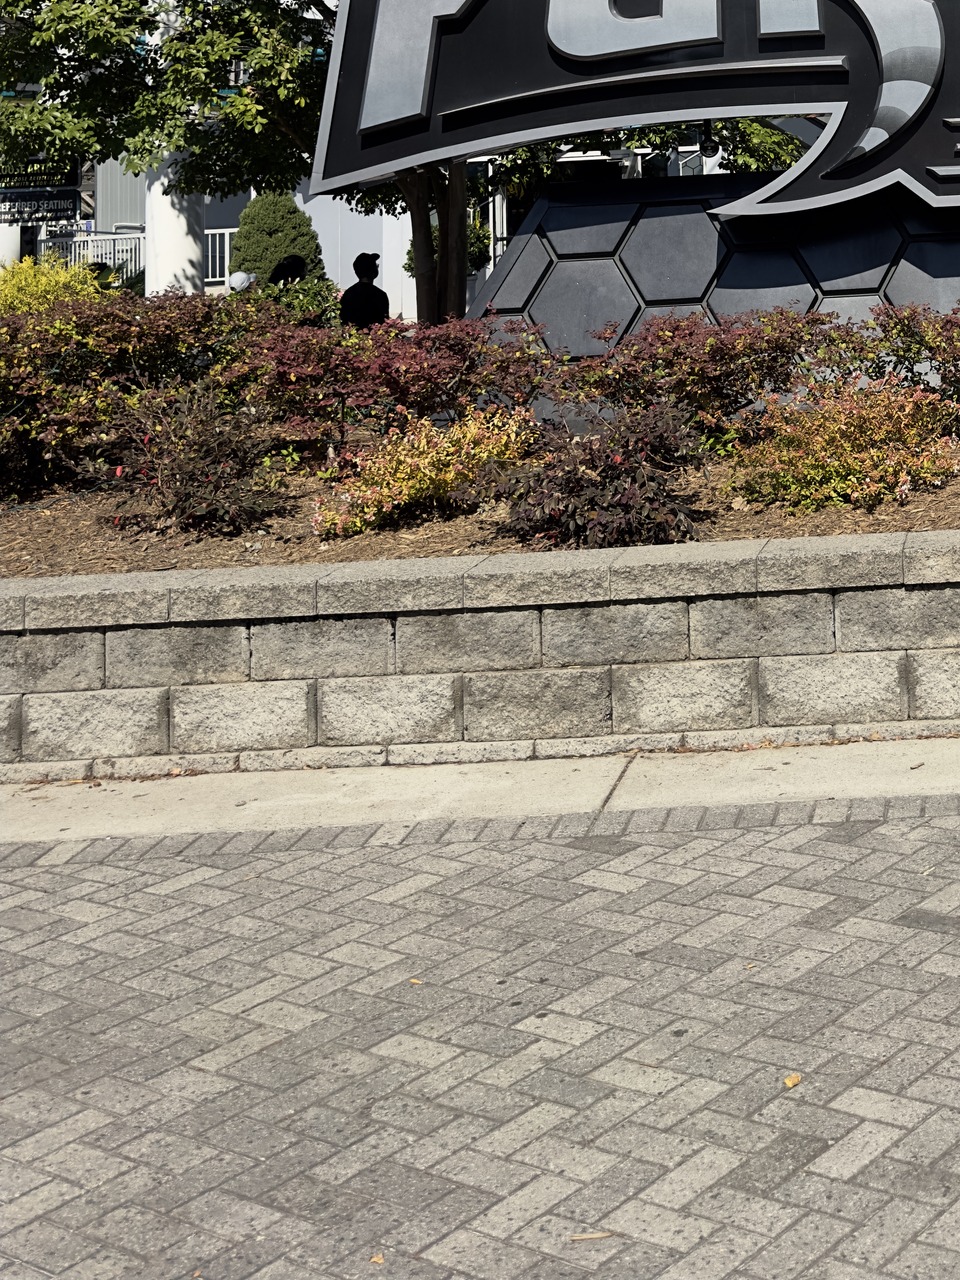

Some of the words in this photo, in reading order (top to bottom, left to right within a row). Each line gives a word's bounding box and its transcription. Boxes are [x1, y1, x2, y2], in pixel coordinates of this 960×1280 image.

[0, 163, 26, 175] OOSE
[0, 201, 38, 212] EFERRED
[38, 199, 74, 211] SEATING
